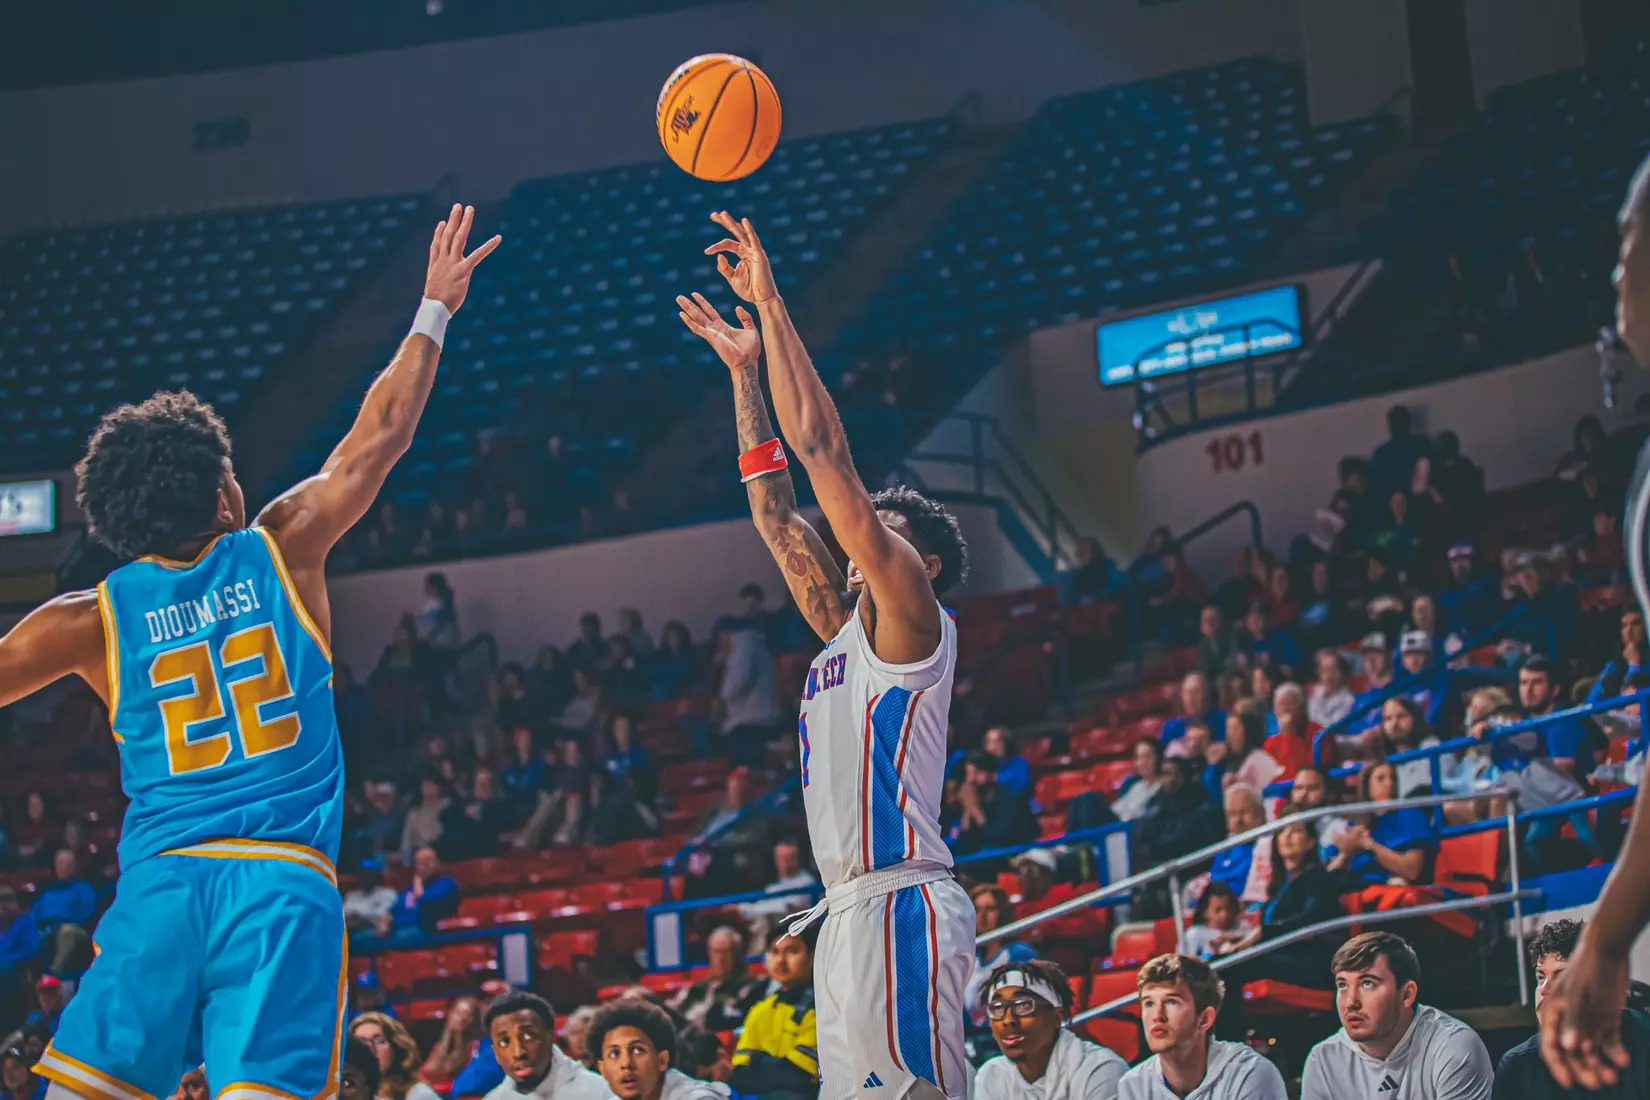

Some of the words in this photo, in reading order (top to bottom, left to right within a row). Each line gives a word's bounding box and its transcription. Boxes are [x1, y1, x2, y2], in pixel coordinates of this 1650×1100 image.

[1205, 429, 1264, 474] 101
[145, 579, 261, 643] DIOUMASSI
[148, 621, 302, 776] 22
